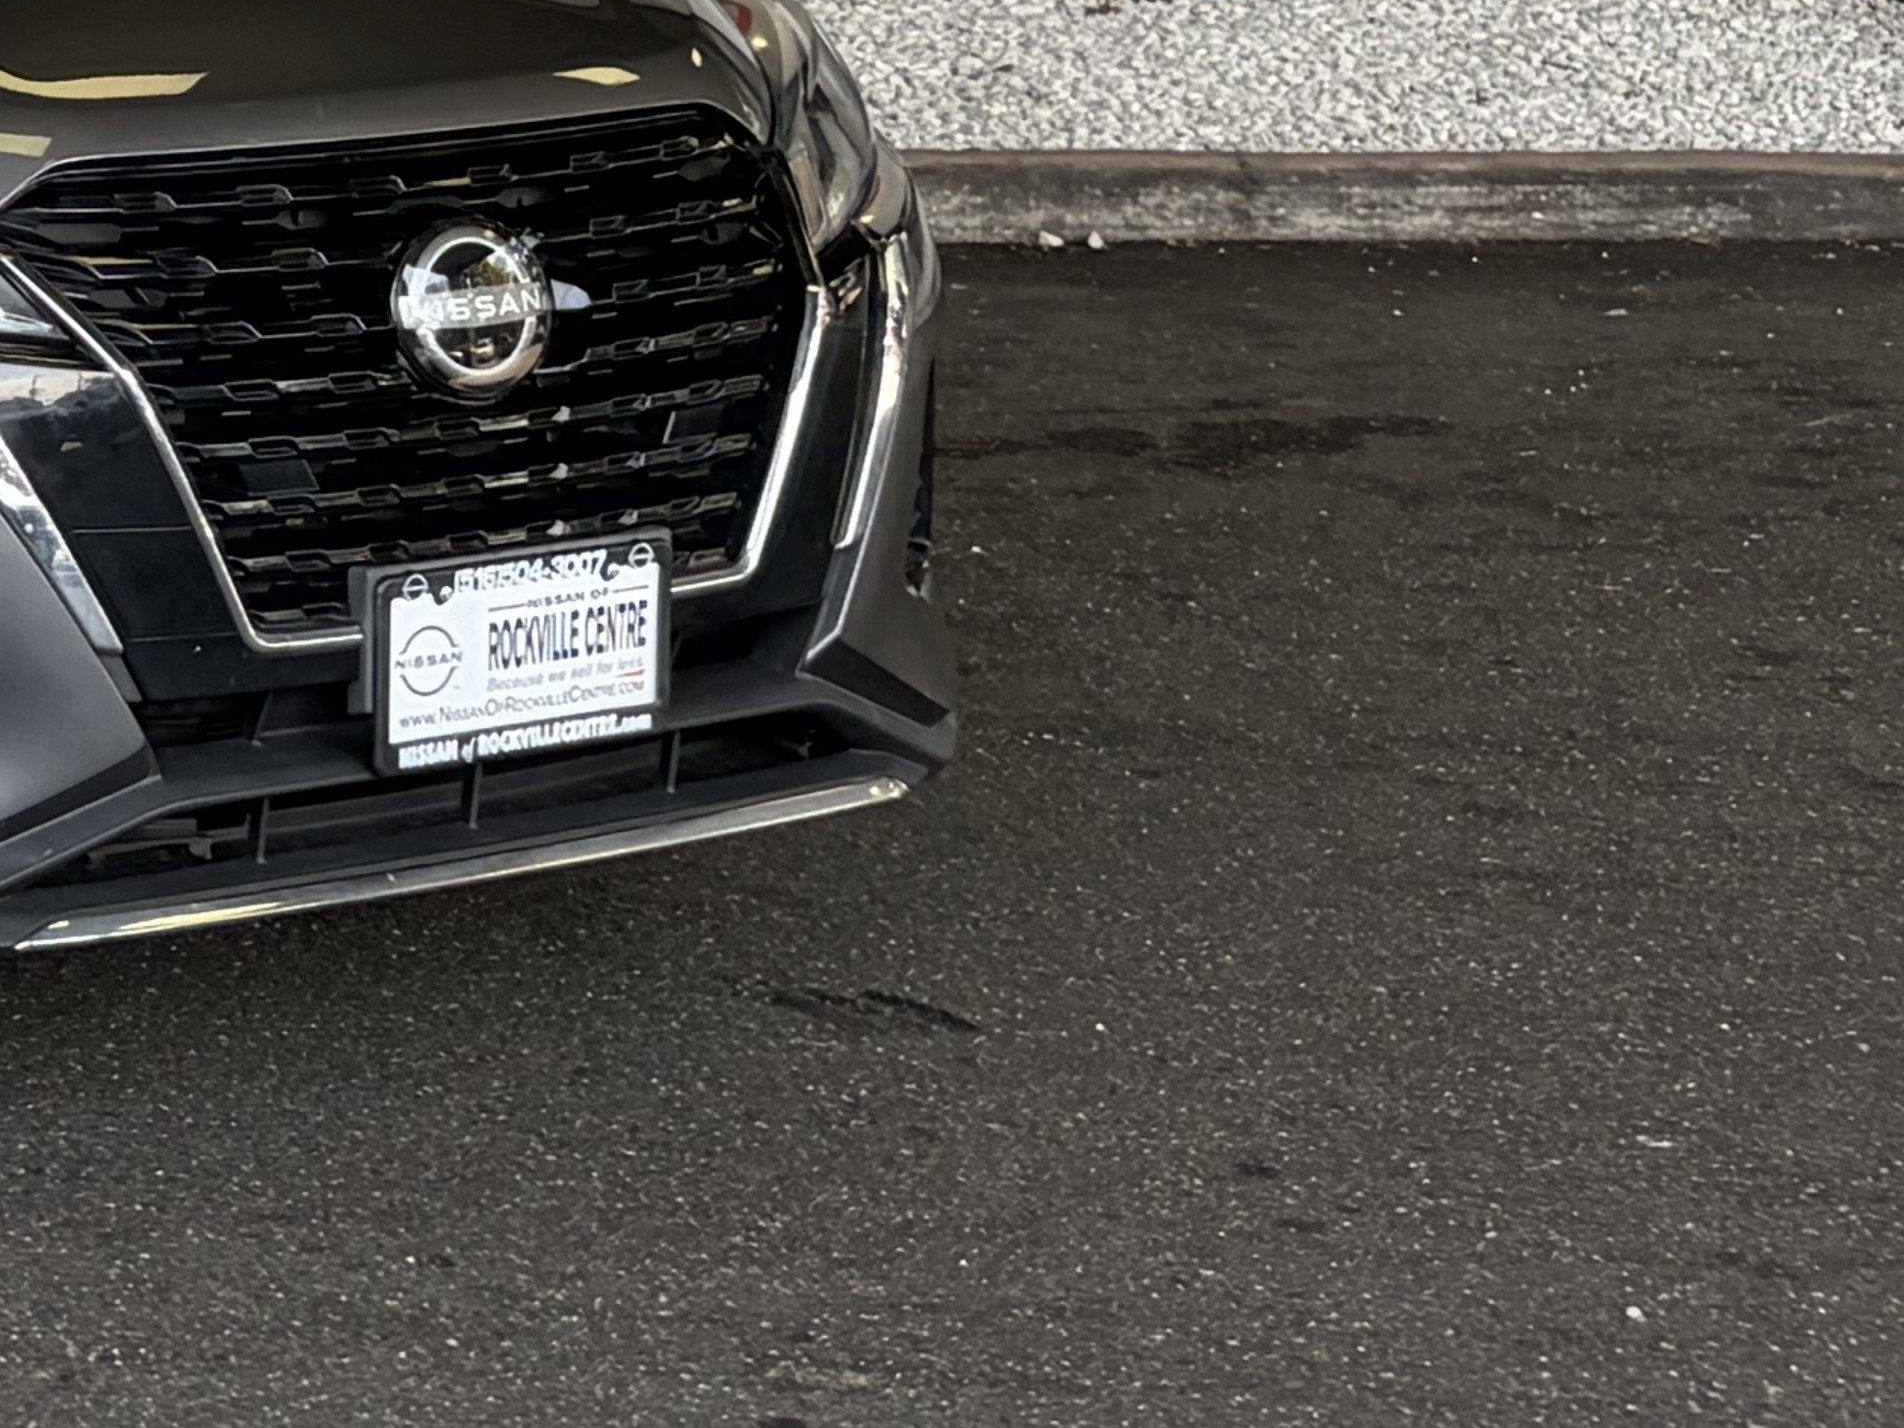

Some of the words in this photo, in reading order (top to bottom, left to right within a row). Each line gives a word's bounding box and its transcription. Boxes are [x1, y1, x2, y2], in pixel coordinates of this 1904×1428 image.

[526, 592, 585, 609] NISSAN
[487, 608, 580, 671] ROCKVILLE
[585, 599, 649, 656] CENTRE
[395, 651, 462, 670] NISSAN
[398, 739, 458, 770] NISSAN
